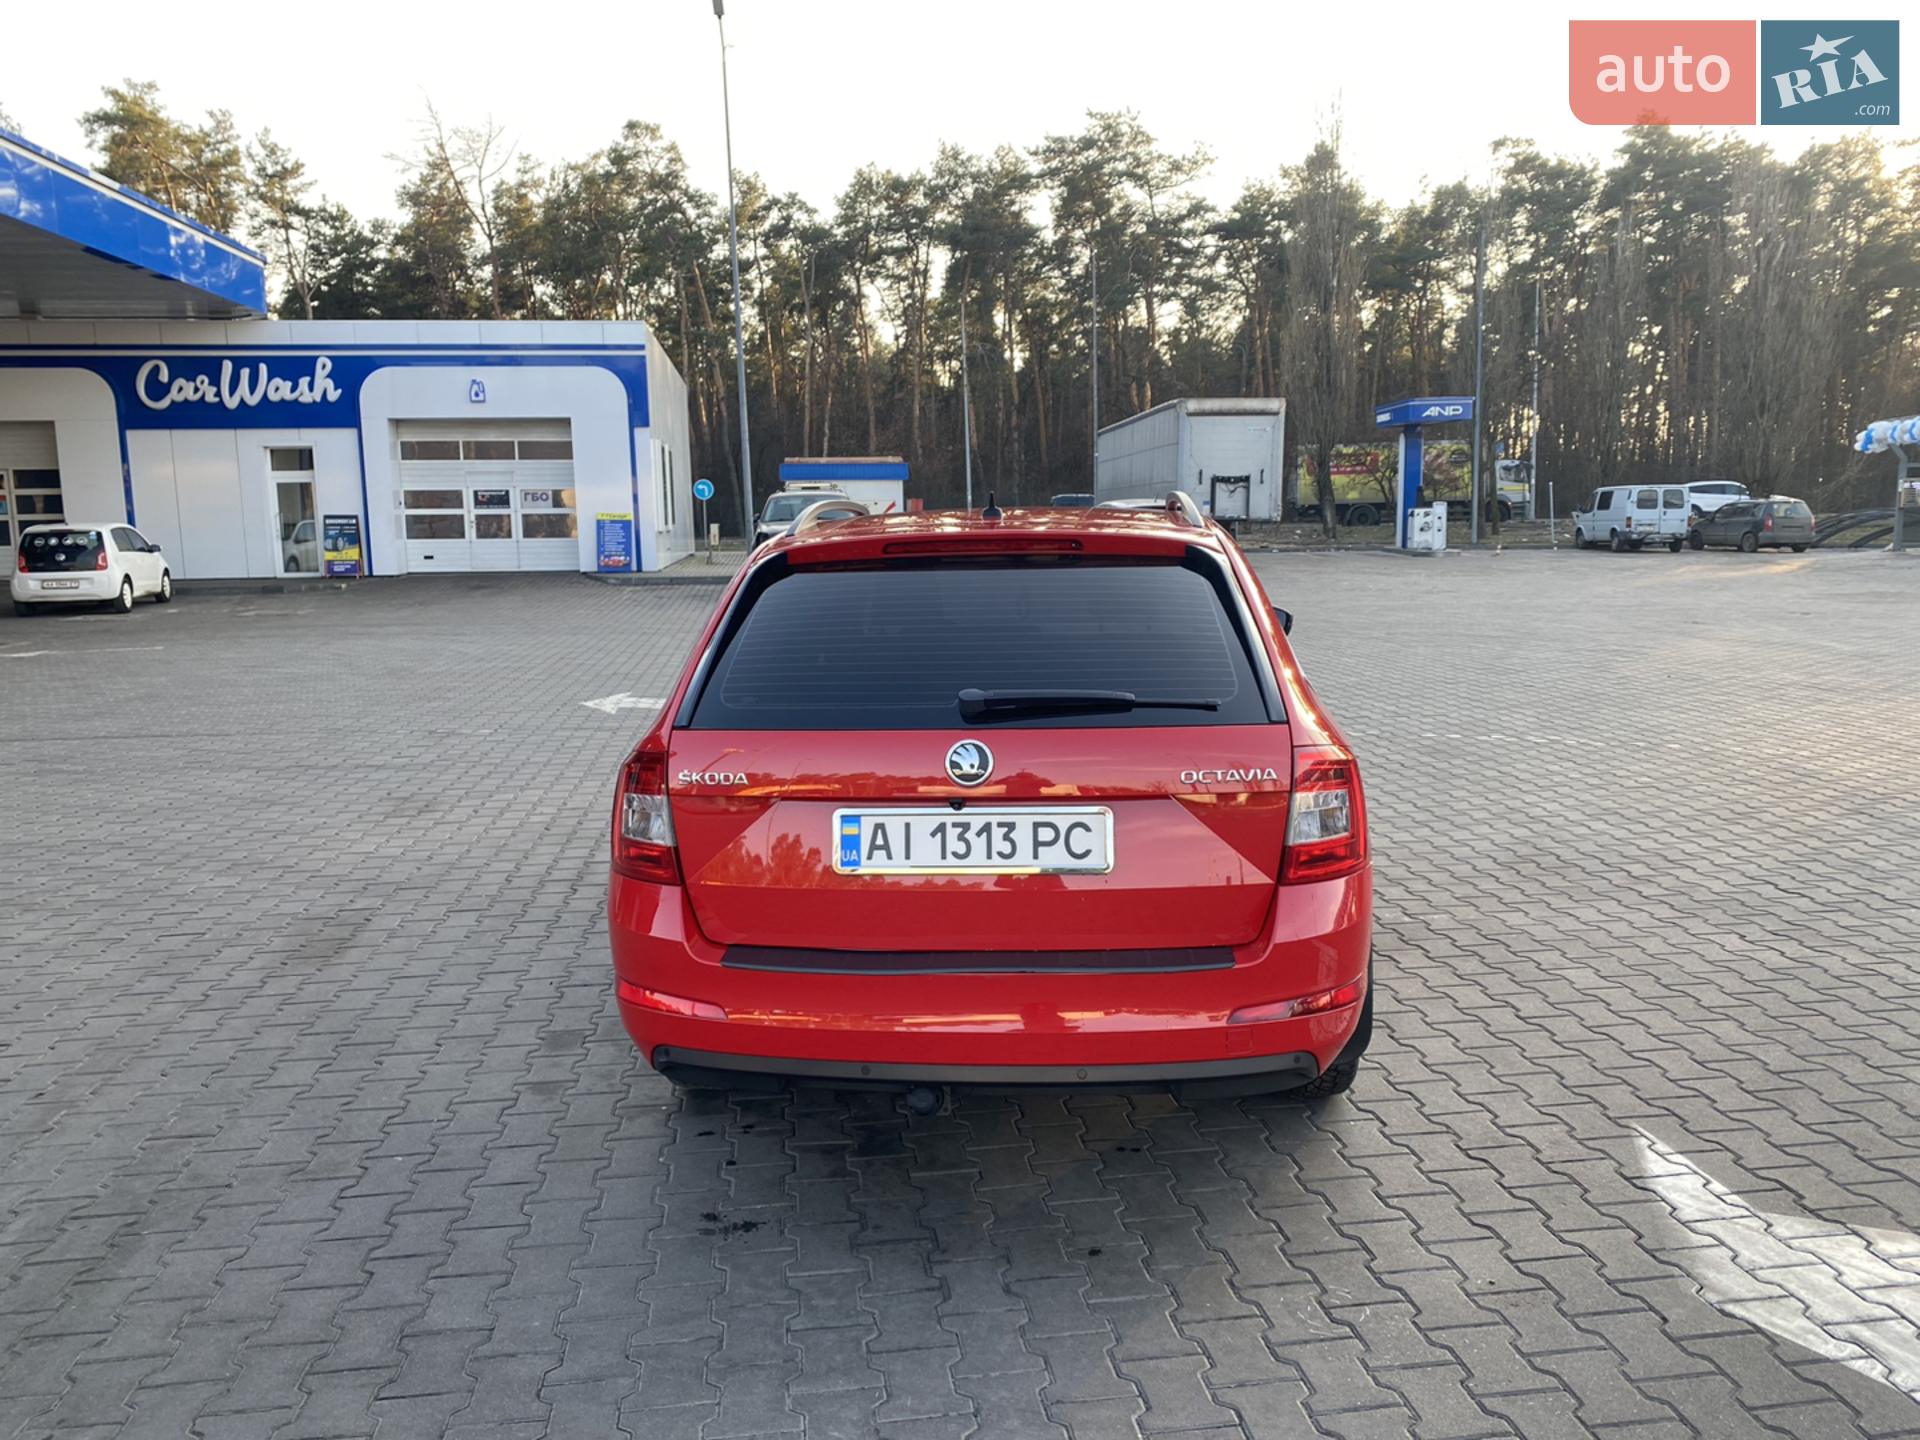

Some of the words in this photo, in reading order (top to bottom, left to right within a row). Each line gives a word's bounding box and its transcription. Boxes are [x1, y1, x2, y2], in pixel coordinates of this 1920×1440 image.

[1421, 405, 1464, 417] ANP
[523, 491, 550, 502] ГБО
[677, 768, 749, 786] ŠKODA
[1179, 767, 1278, 785] OCTAVIA
[866, 821, 912, 861] AI
[930, 821, 1018, 861] 1313
[1031, 820, 1094, 861] PC
[840, 851, 860, 862] UA
